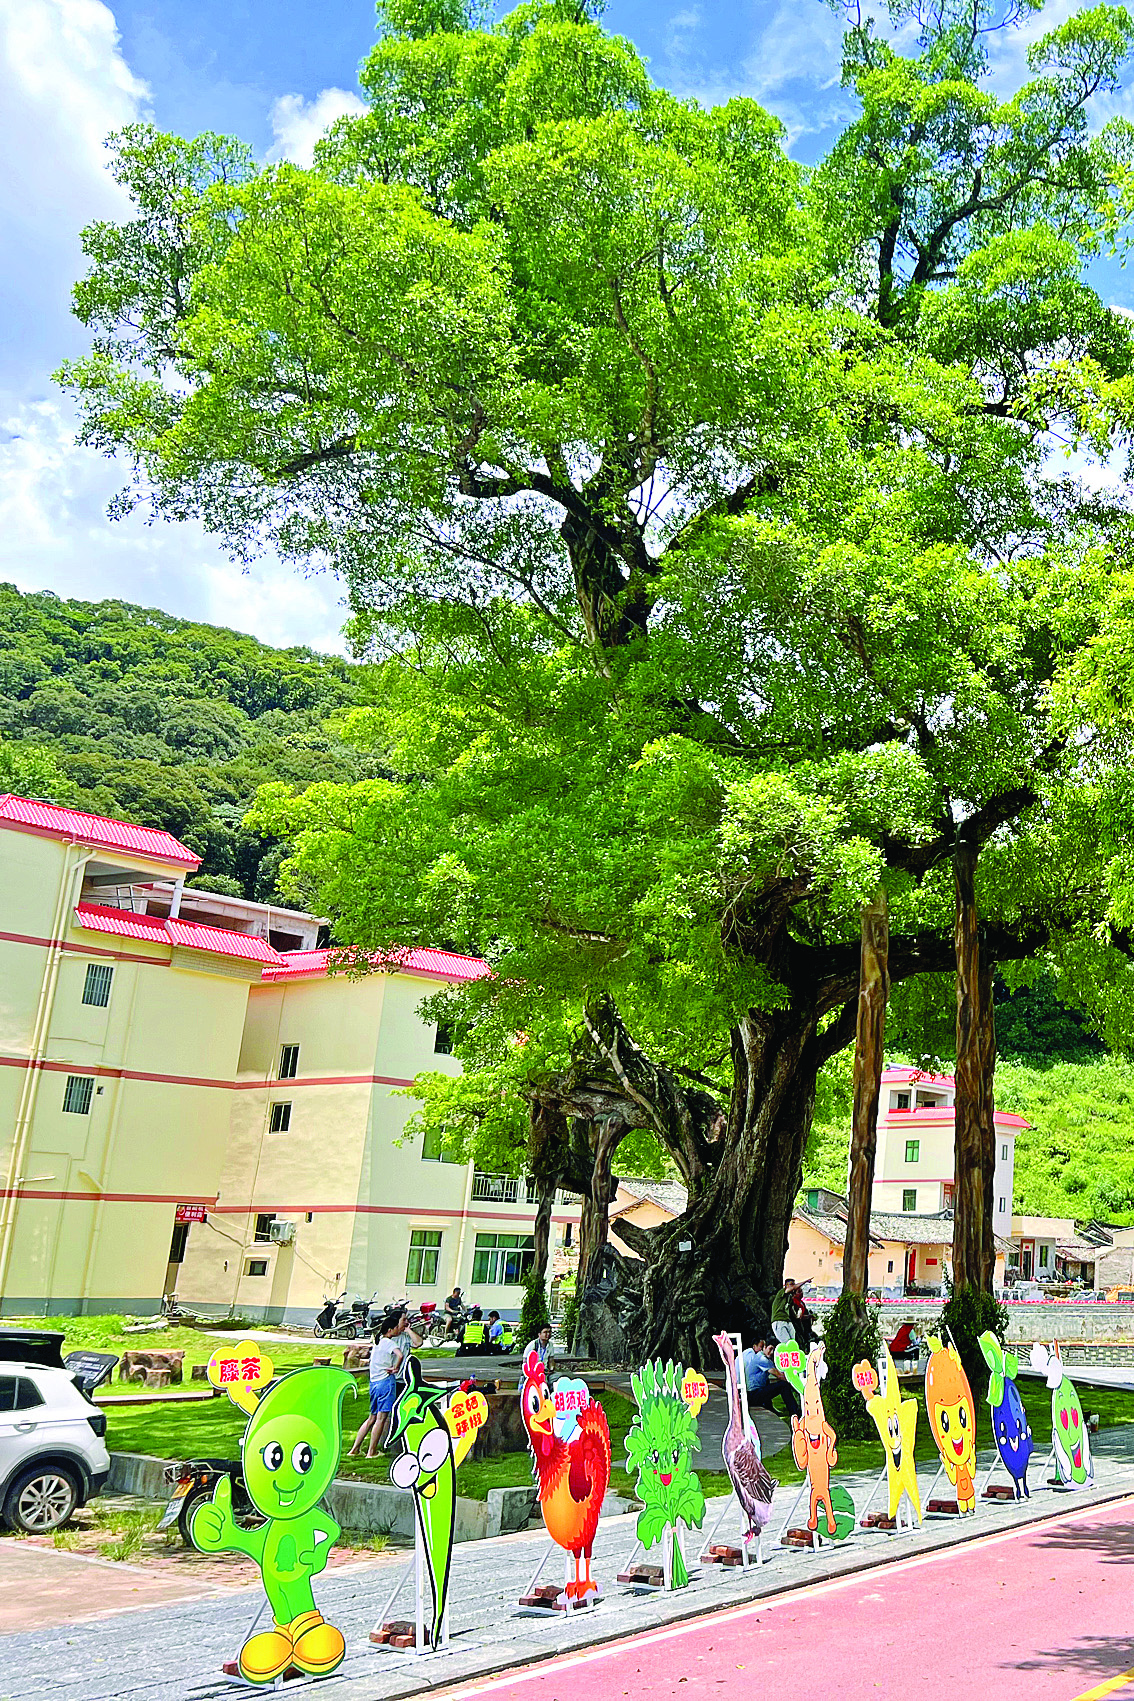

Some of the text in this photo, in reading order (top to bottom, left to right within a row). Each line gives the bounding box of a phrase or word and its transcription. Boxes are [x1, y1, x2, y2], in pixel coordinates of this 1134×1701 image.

[219, 1357, 261, 1383] 藤茶
[779, 1352, 801, 1368] 粉葛
[451, 1395, 479, 1418] 富硒
[554, 1389, 588, 1412] 胡须鸡
[455, 1412, 483, 1436] 辣椒
